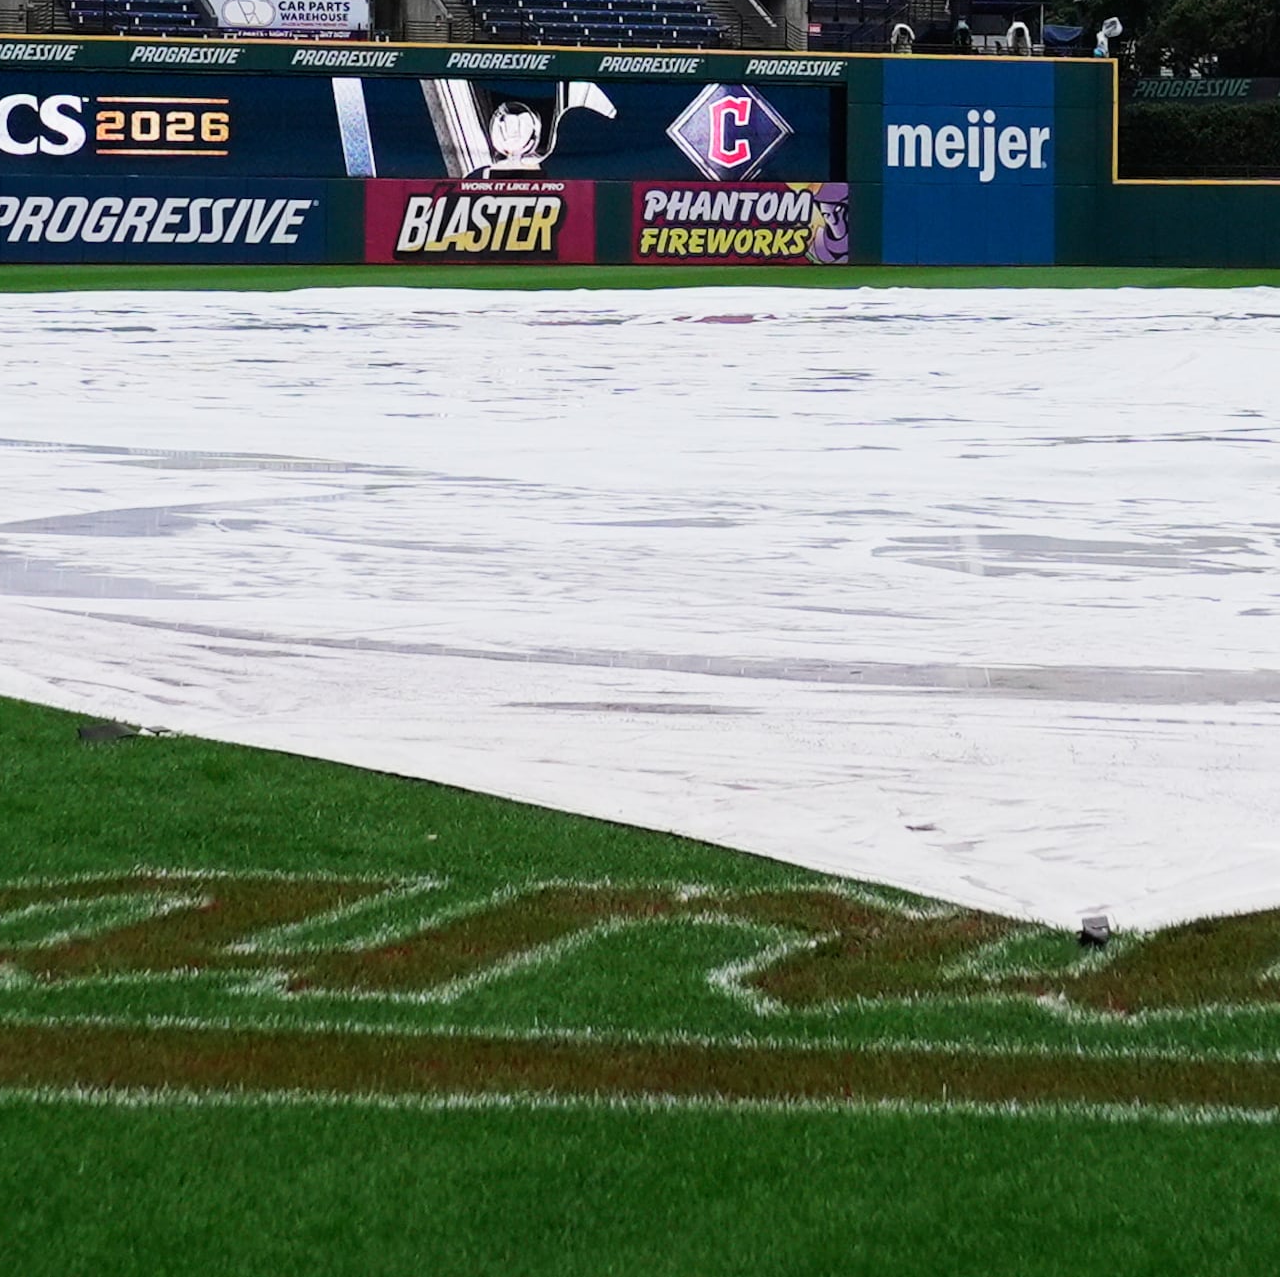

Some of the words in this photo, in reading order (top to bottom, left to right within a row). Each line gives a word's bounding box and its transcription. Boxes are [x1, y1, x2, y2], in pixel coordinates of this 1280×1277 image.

[278, 0, 306, 11] CAR
[308, 1, 351, 12] PARTS
[280, 12, 349, 22] WAREHOUSE
[129, 45, 241, 66] PROGRESSIVE
[291, 48, 400, 69] PROGRESSIVE
[445, 52, 552, 71] PROGRESSIVE
[597, 56, 701, 75] PROGRESSIVE
[745, 58, 846, 78] PROGRESSIVE
[1131, 78, 1253, 98] PROGRESSIVE
[95, 110, 230, 142] 2026
[708, 94, 753, 169] C
[886, 109, 1051, 183] meijer
[460, 182, 493, 191] WORK
[494, 182, 506, 191] IT
[506, 182, 530, 191] LIKE
[530, 182, 540, 191] A
[541, 182, 566, 191] PRO
[642, 188, 813, 222] PHANTOM
[396, 195, 563, 252] BLASTER
[639, 227, 809, 256] FIREWORKS
